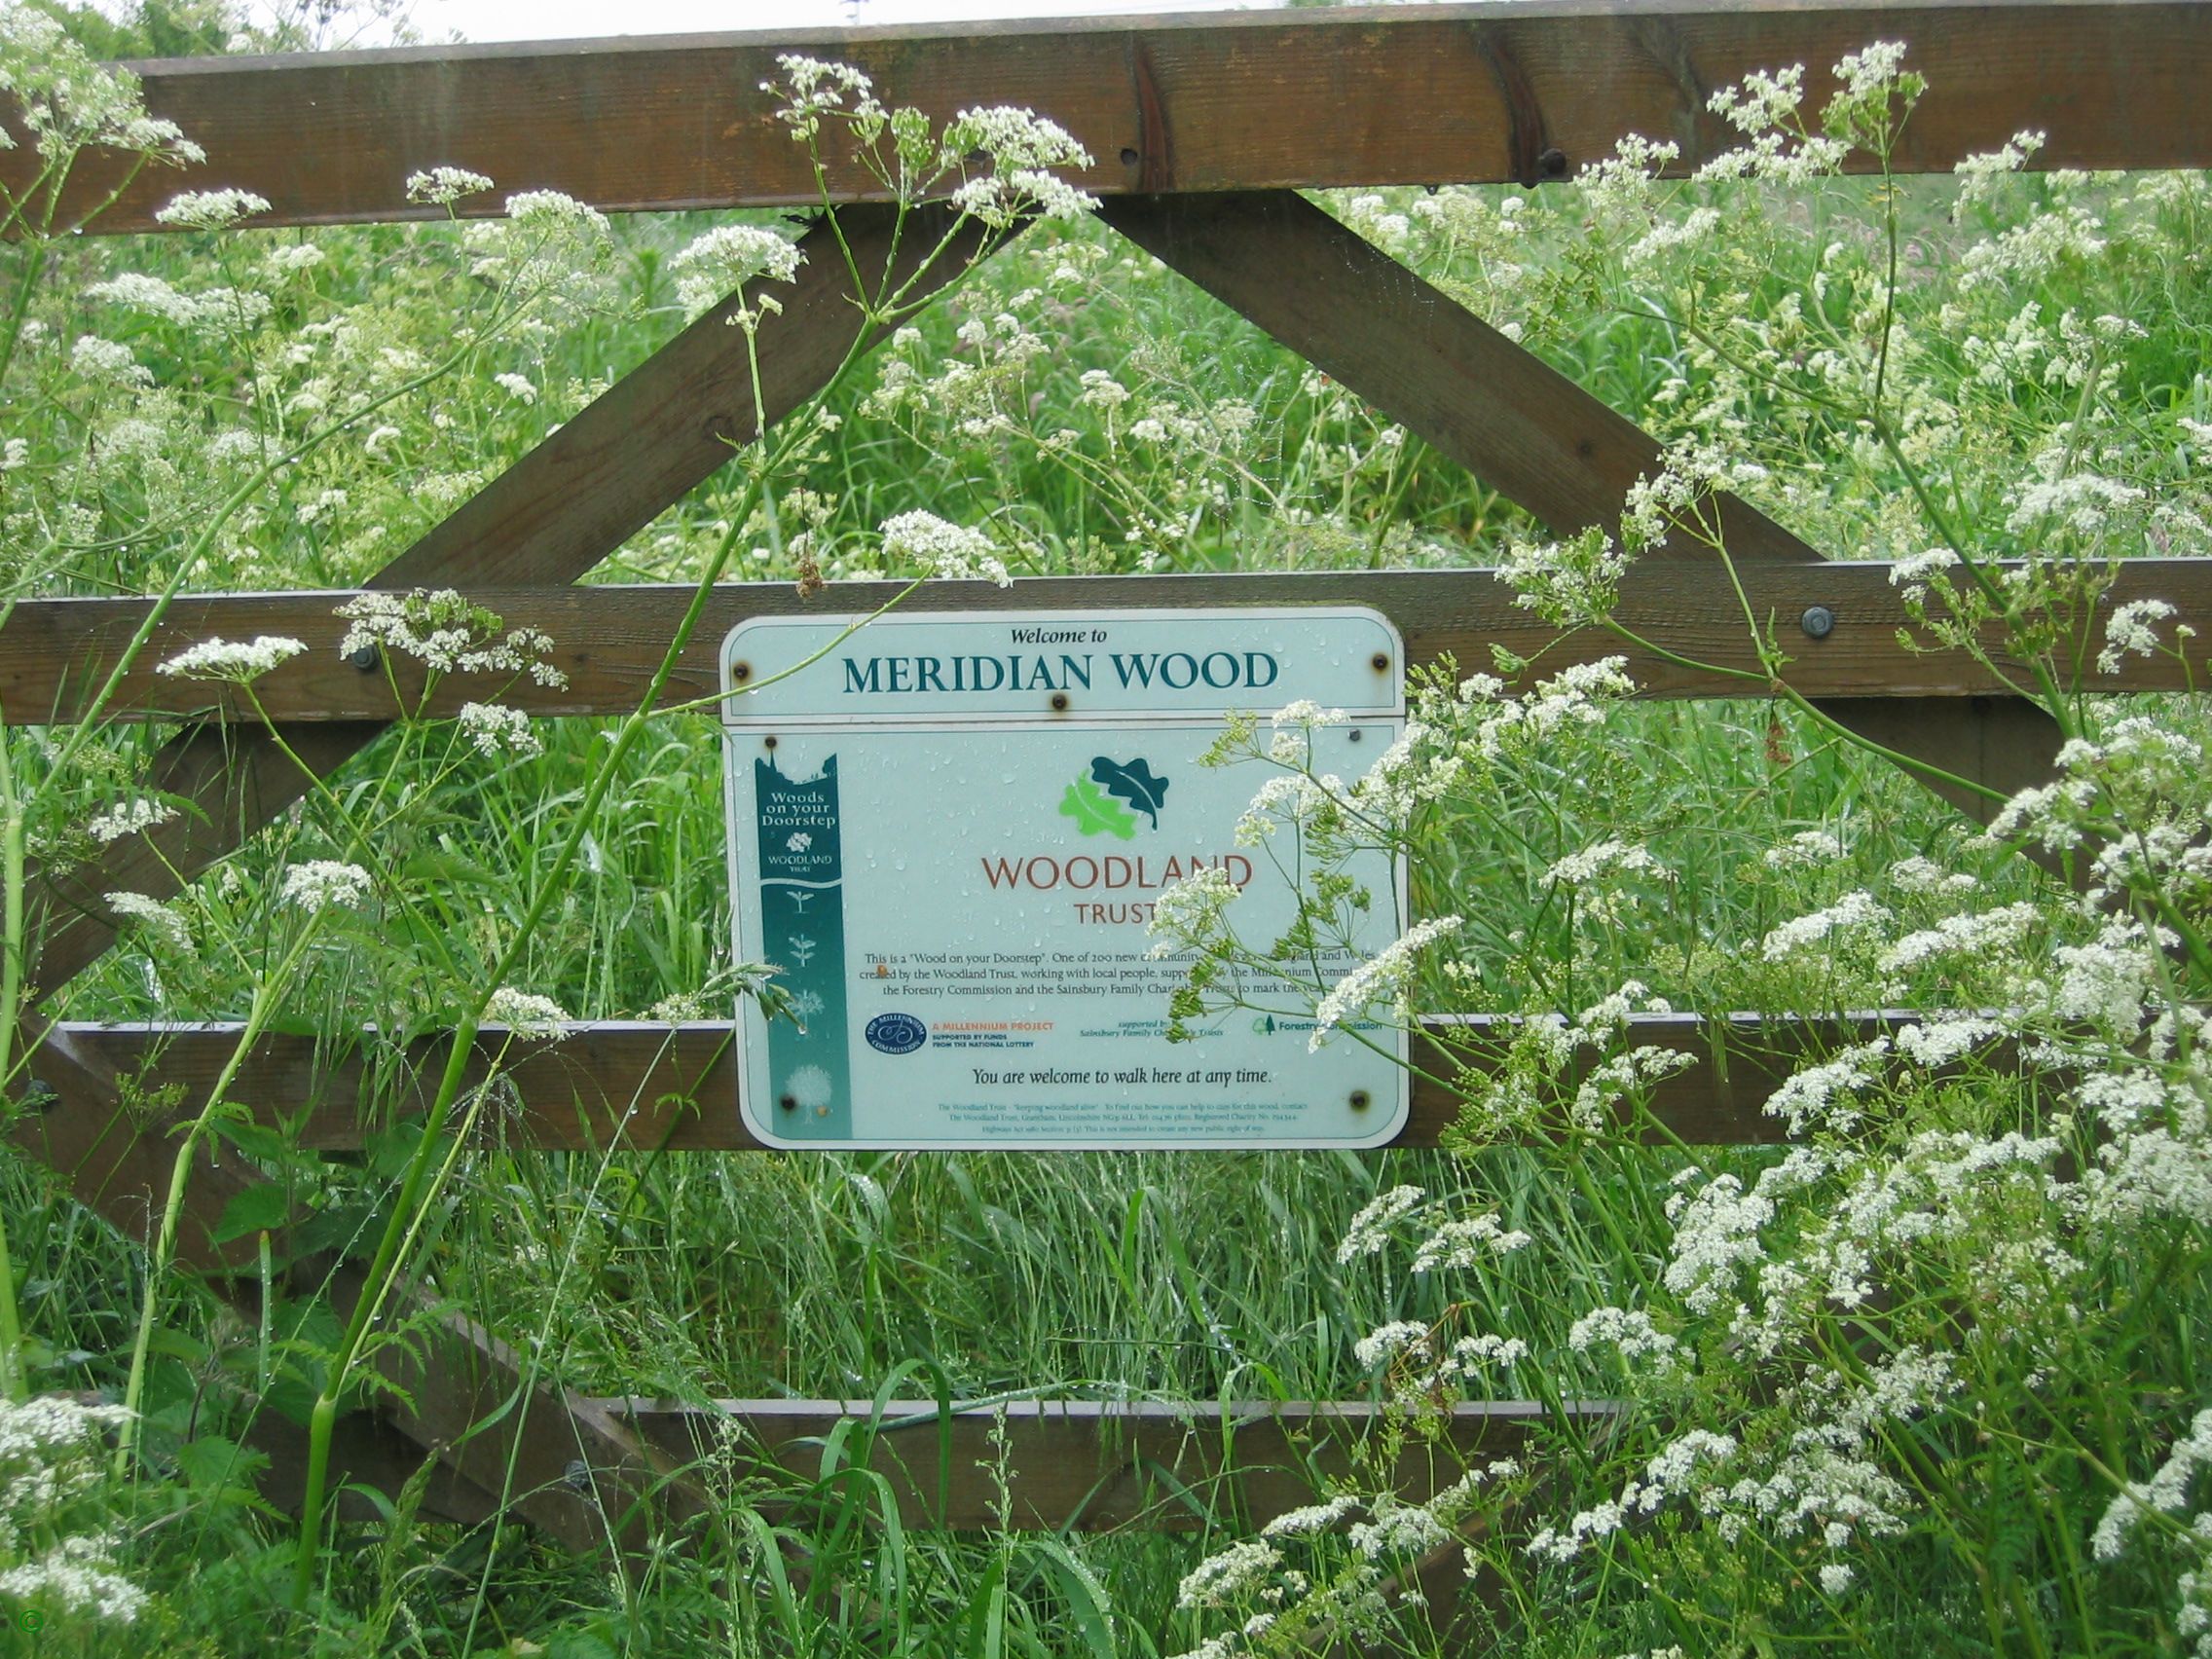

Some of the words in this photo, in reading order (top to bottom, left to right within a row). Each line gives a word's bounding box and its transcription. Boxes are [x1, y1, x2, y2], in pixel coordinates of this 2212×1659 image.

[1011, 628, 1086, 644] Welcome
[1091, 628, 1108, 643] to
[841, 654, 1094, 693] MERIDIAN
[1109, 651, 1278, 689] WOOD
[771, 791, 825, 803] Woods
[766, 804, 787, 814] on
[793, 804, 830, 817] your
[762, 815, 836, 830] Doorstep
[768, 856, 832, 865] WOODLAND
[1074, 903, 1158, 924] TRUST
[866, 953, 887, 964] This
[890, 953, 898, 964] is
[967, 955, 990, 966] your
[1052, 952, 1075, 962] One
[1078, 951, 1089, 962] of
[1321, 949, 1341, 960] and
[900, 969, 910, 981] by
[914, 969, 930, 978] the
[934, 968, 986, 978] Woodland
[1022, 968, 1063, 980] working
[1067, 968, 1089, 977] with
[1093, 968, 1117, 977] local
[883, 985, 899, 995] the
[903, 985, 944, 998] Forestry
[947, 984, 1012, 995] Commission
[1015, 984, 1034, 994] and
[1038, 984, 1053, 994] the
[1056, 984, 1107, 997] Sainsbury
[1111, 983, 1143, 996] Family
[1253, 983, 1279, 993] mark
[932, 1022, 940, 1031] A
[942, 1022, 1008, 1031] MILLENNIUM
[1011, 1022, 1054, 1031] PROJECT
[1119, 1020, 1158, 1029] supported
[1080, 1029, 1120, 1038] Sainsbury
[1123, 1029, 1151, 1038] Family
[974, 1069, 998, 1084] You
[1003, 1072, 1024, 1084] are
[1029, 1068, 1090, 1084] welcome
[1095, 1070, 1109, 1083] to
[1114, 1068, 1149, 1083] walk
[1153, 1068, 1182, 1083] here
[1187, 1070, 1201, 1083] at
[1205, 1072, 1231, 1088] any
[1236, 1069, 1272, 1083] time.
